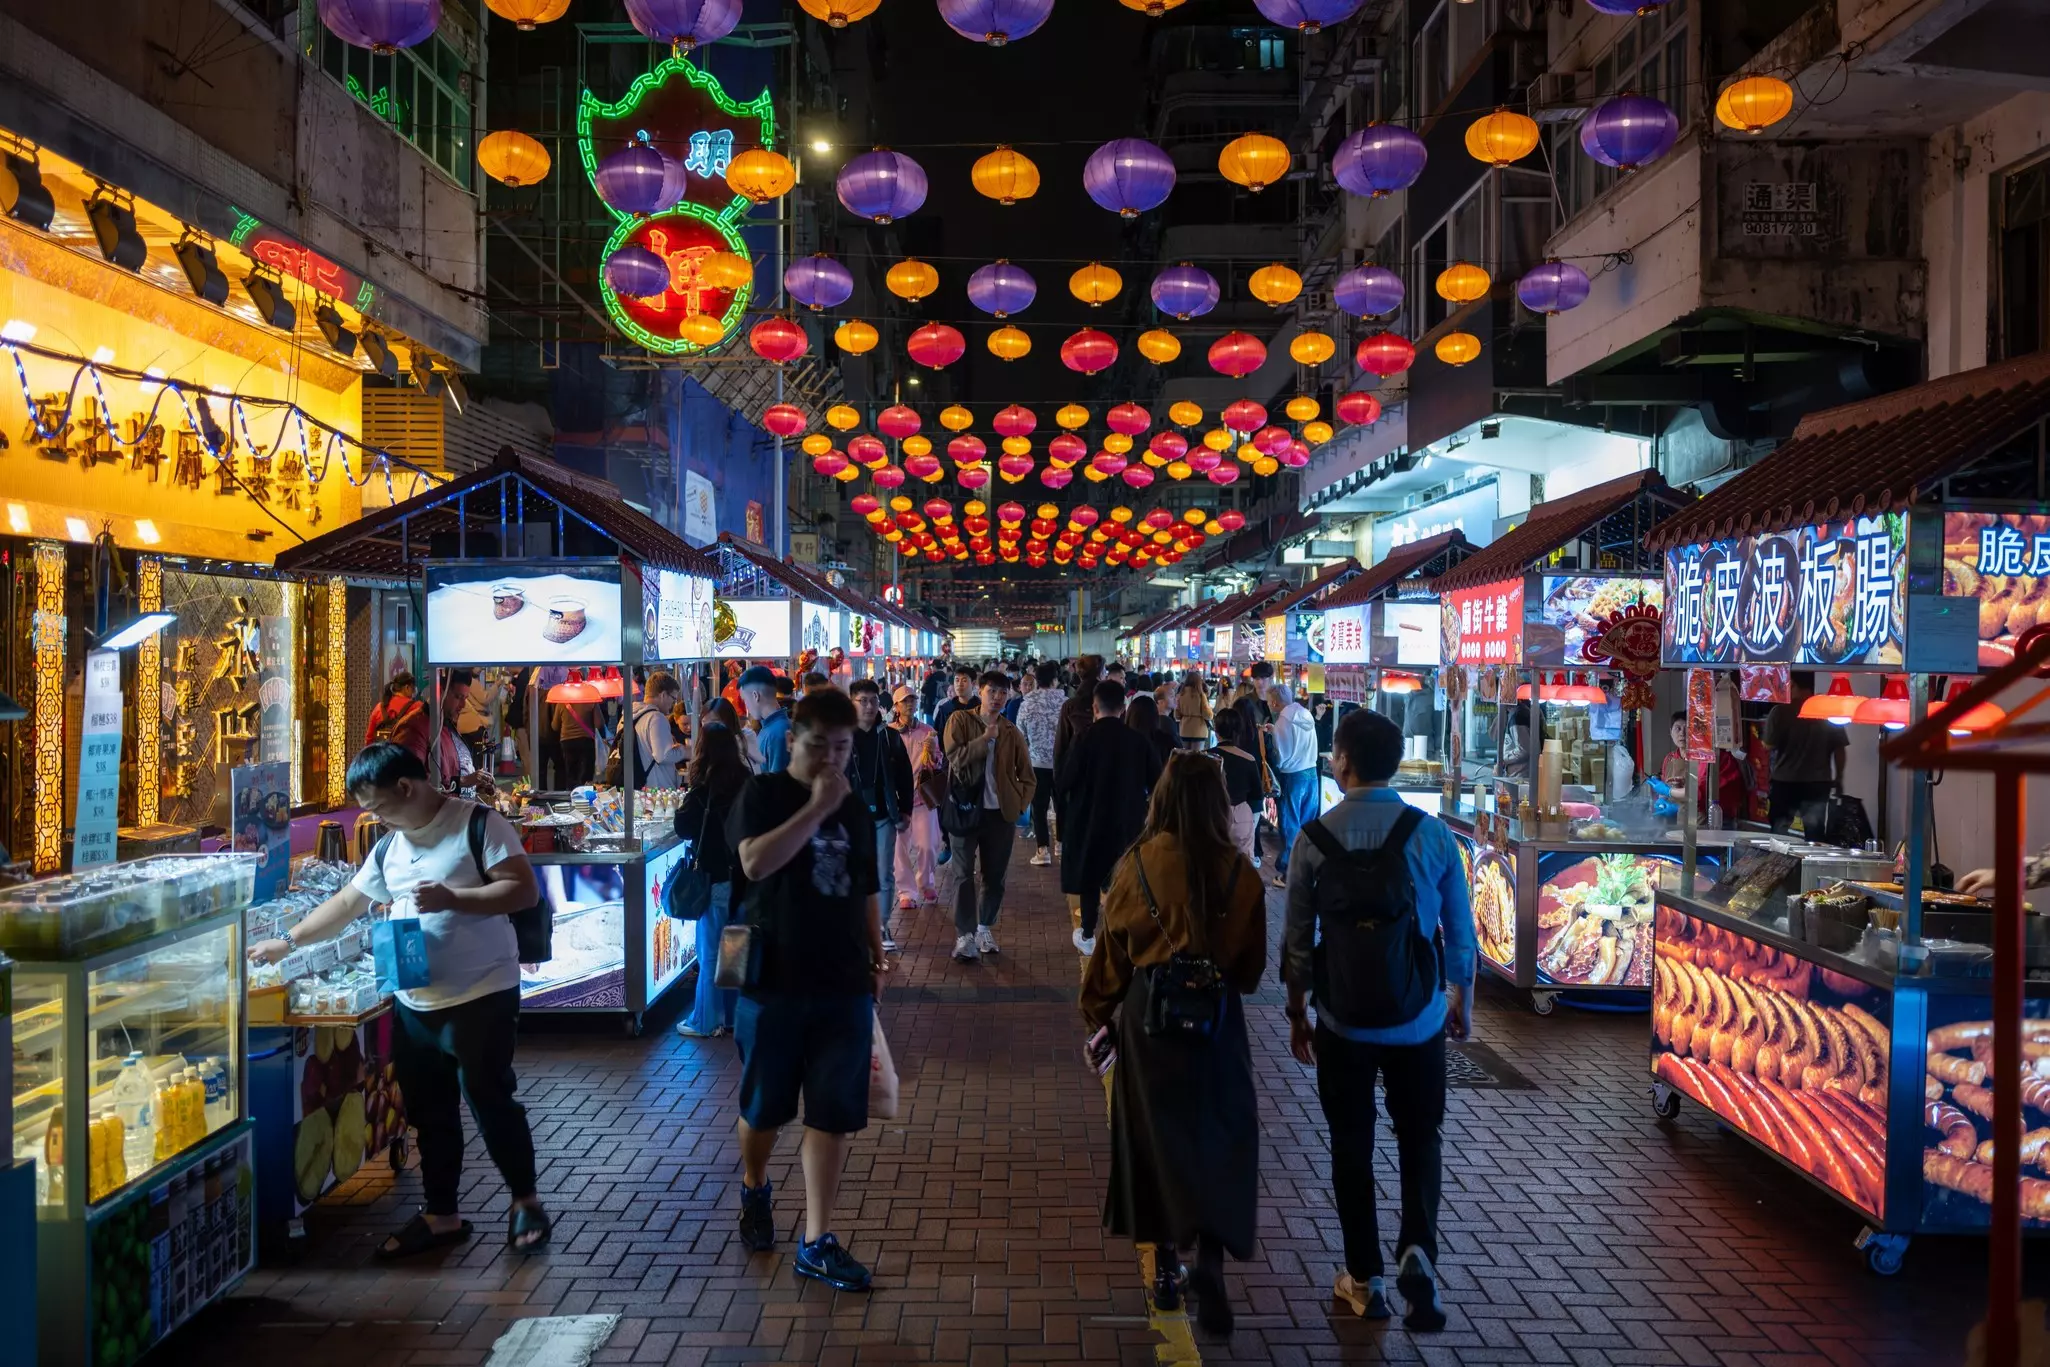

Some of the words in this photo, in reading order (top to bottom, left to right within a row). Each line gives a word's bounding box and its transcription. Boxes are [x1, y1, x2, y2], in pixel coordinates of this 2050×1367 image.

[1674, 533, 1892, 646] 脆皮波板腸
[1330, 618, 1362, 652] 多寶美食
